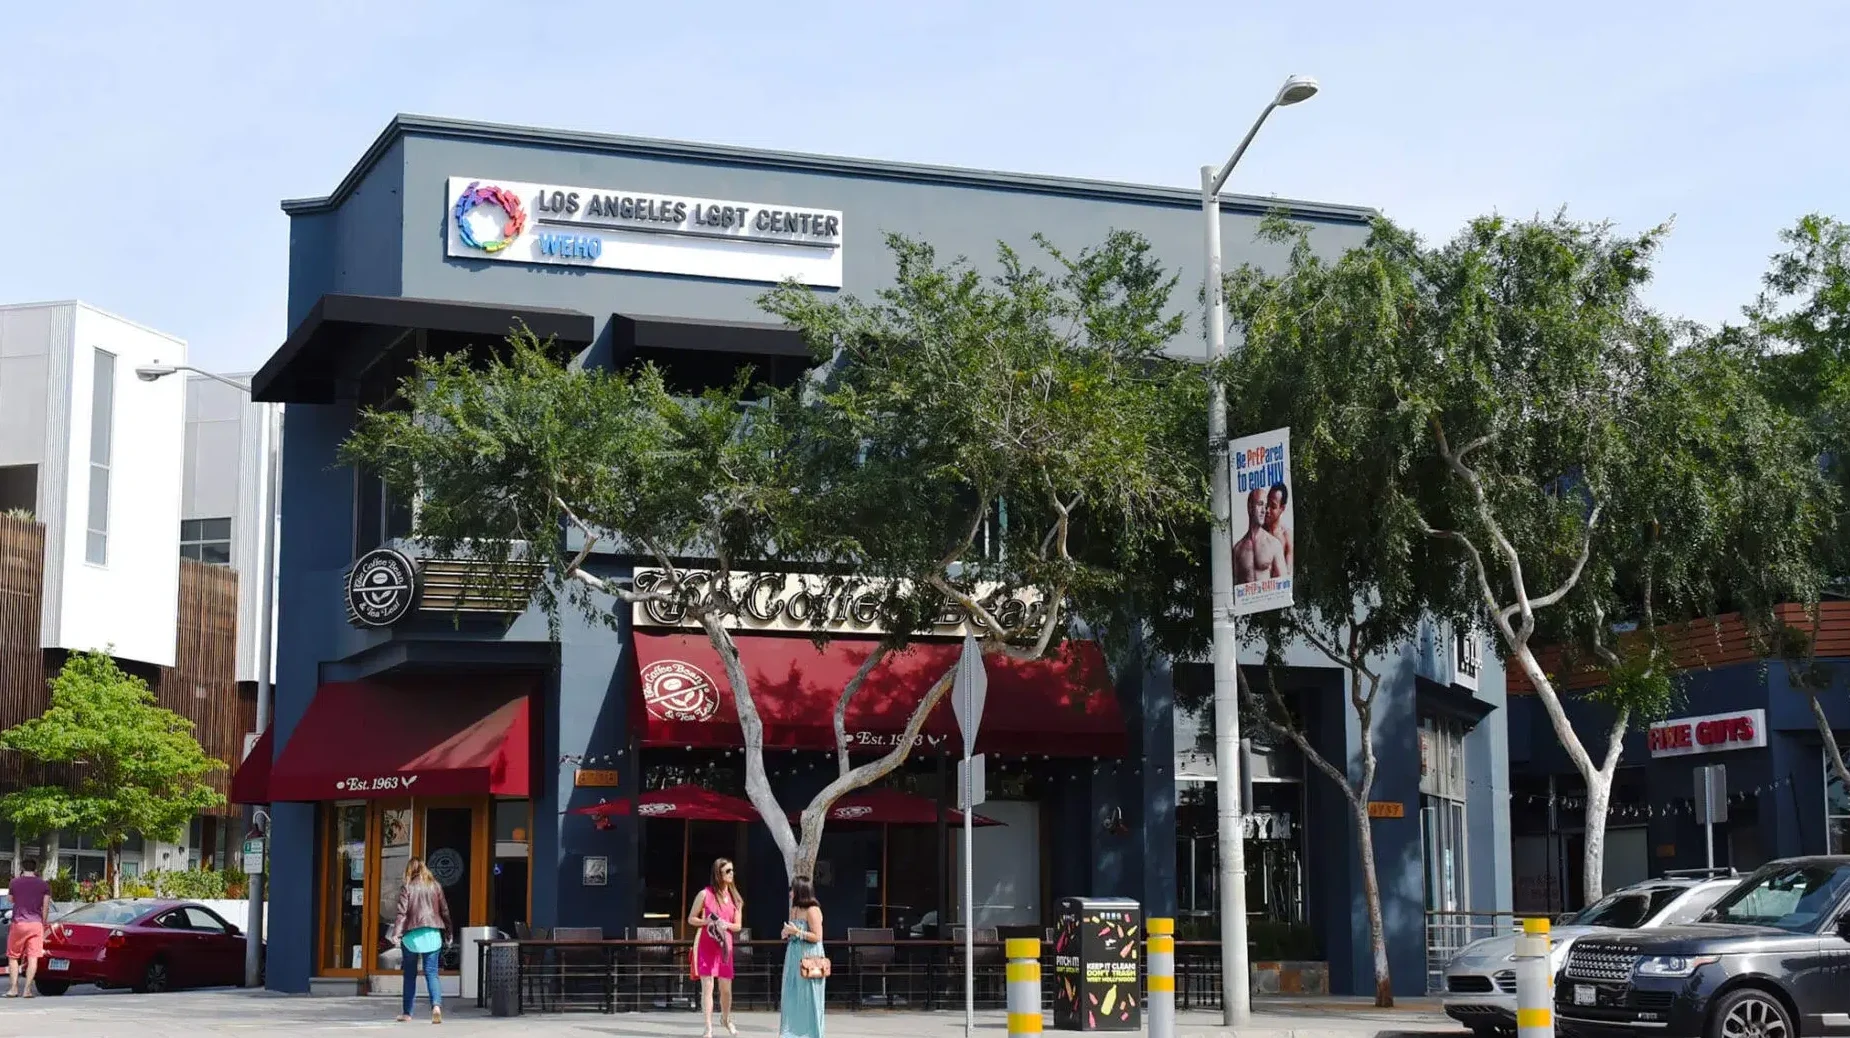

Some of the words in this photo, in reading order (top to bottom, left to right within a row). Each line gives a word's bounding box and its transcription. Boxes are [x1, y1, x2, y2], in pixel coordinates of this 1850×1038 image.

[539, 188, 580, 214] LOS
[587, 193, 688, 224] ANGELES
[694, 203, 750, 229] LGBT
[756, 209, 840, 237] CENTER
[538, 231, 603, 260] WEHO
[1236, 451, 1246, 469] Be
[1247, 442, 1284, 467] PrEPared
[1237, 471, 1247, 492] to
[1249, 465, 1266, 490] end
[1267, 460, 1284, 488] HIV
[362, 556, 388, 573] Coffee
[388, 559, 405, 584] Bean
[367, 606, 381, 618] Tea
[381, 598, 400, 617] Leaf
[644, 665, 673, 683] Coffee
[672, 663, 704, 685] Bean
[856, 731, 887, 746] Est.
[889, 733, 924, 747] 193
[1695, 716, 1755, 746] GUYS
[346, 777, 370, 792] Est.
[371, 776, 399, 790] 1963
[1086, 962, 1104, 970] KEEP
[1104, 962, 1111, 970] IT
